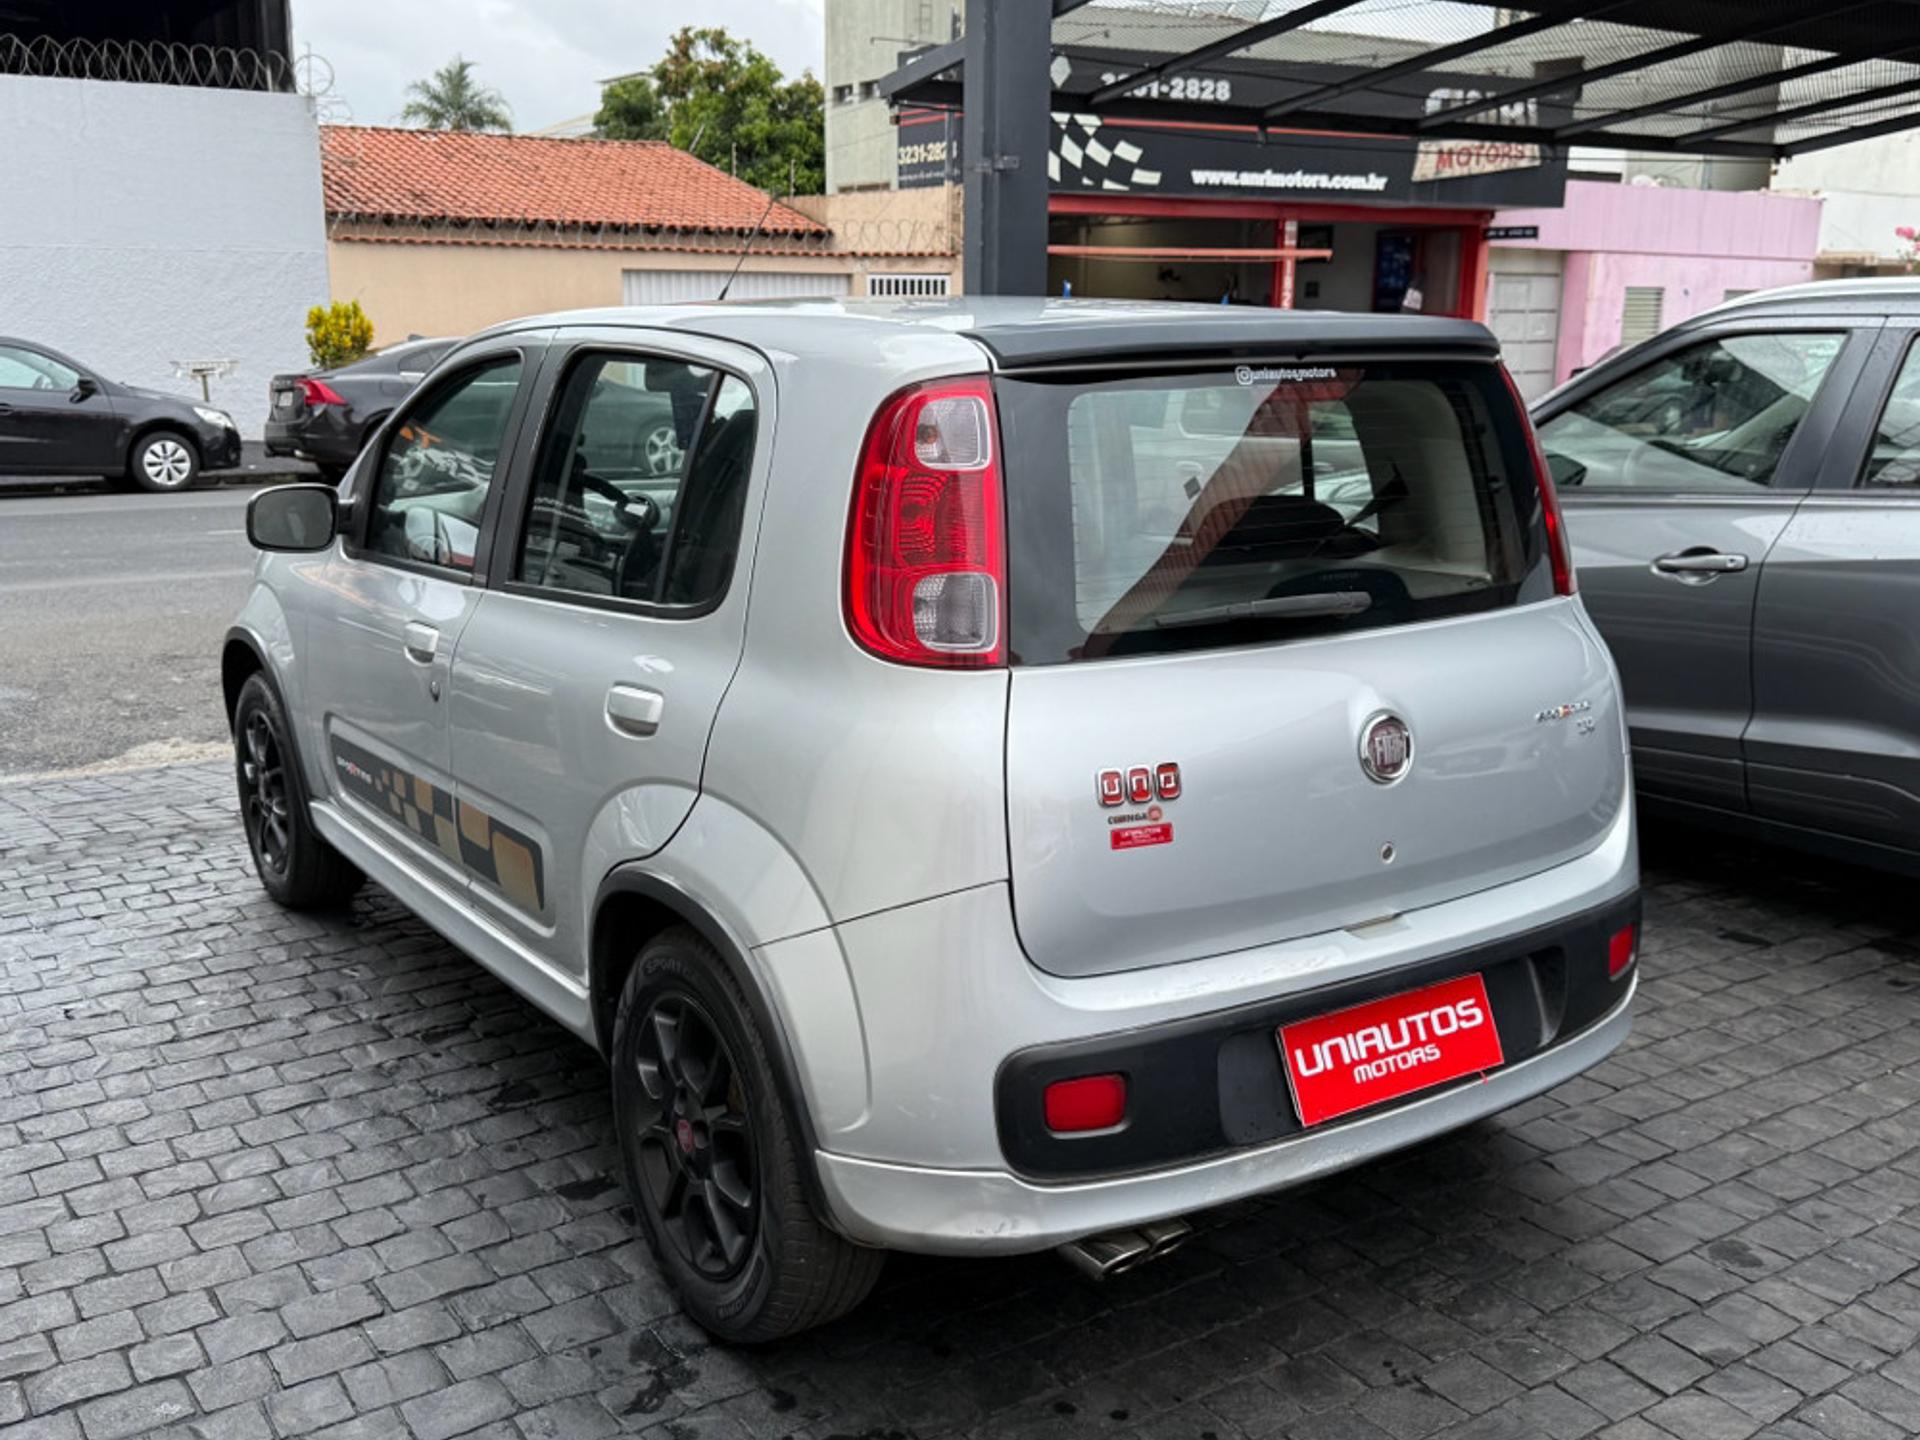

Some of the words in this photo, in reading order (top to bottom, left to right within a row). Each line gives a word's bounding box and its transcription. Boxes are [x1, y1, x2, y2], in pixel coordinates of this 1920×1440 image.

[1435, 144, 1526, 171] MOTORS
[1295, 998, 1484, 1078] UNIAUTOS
[1353, 1043, 1441, 1084] MOTORS
